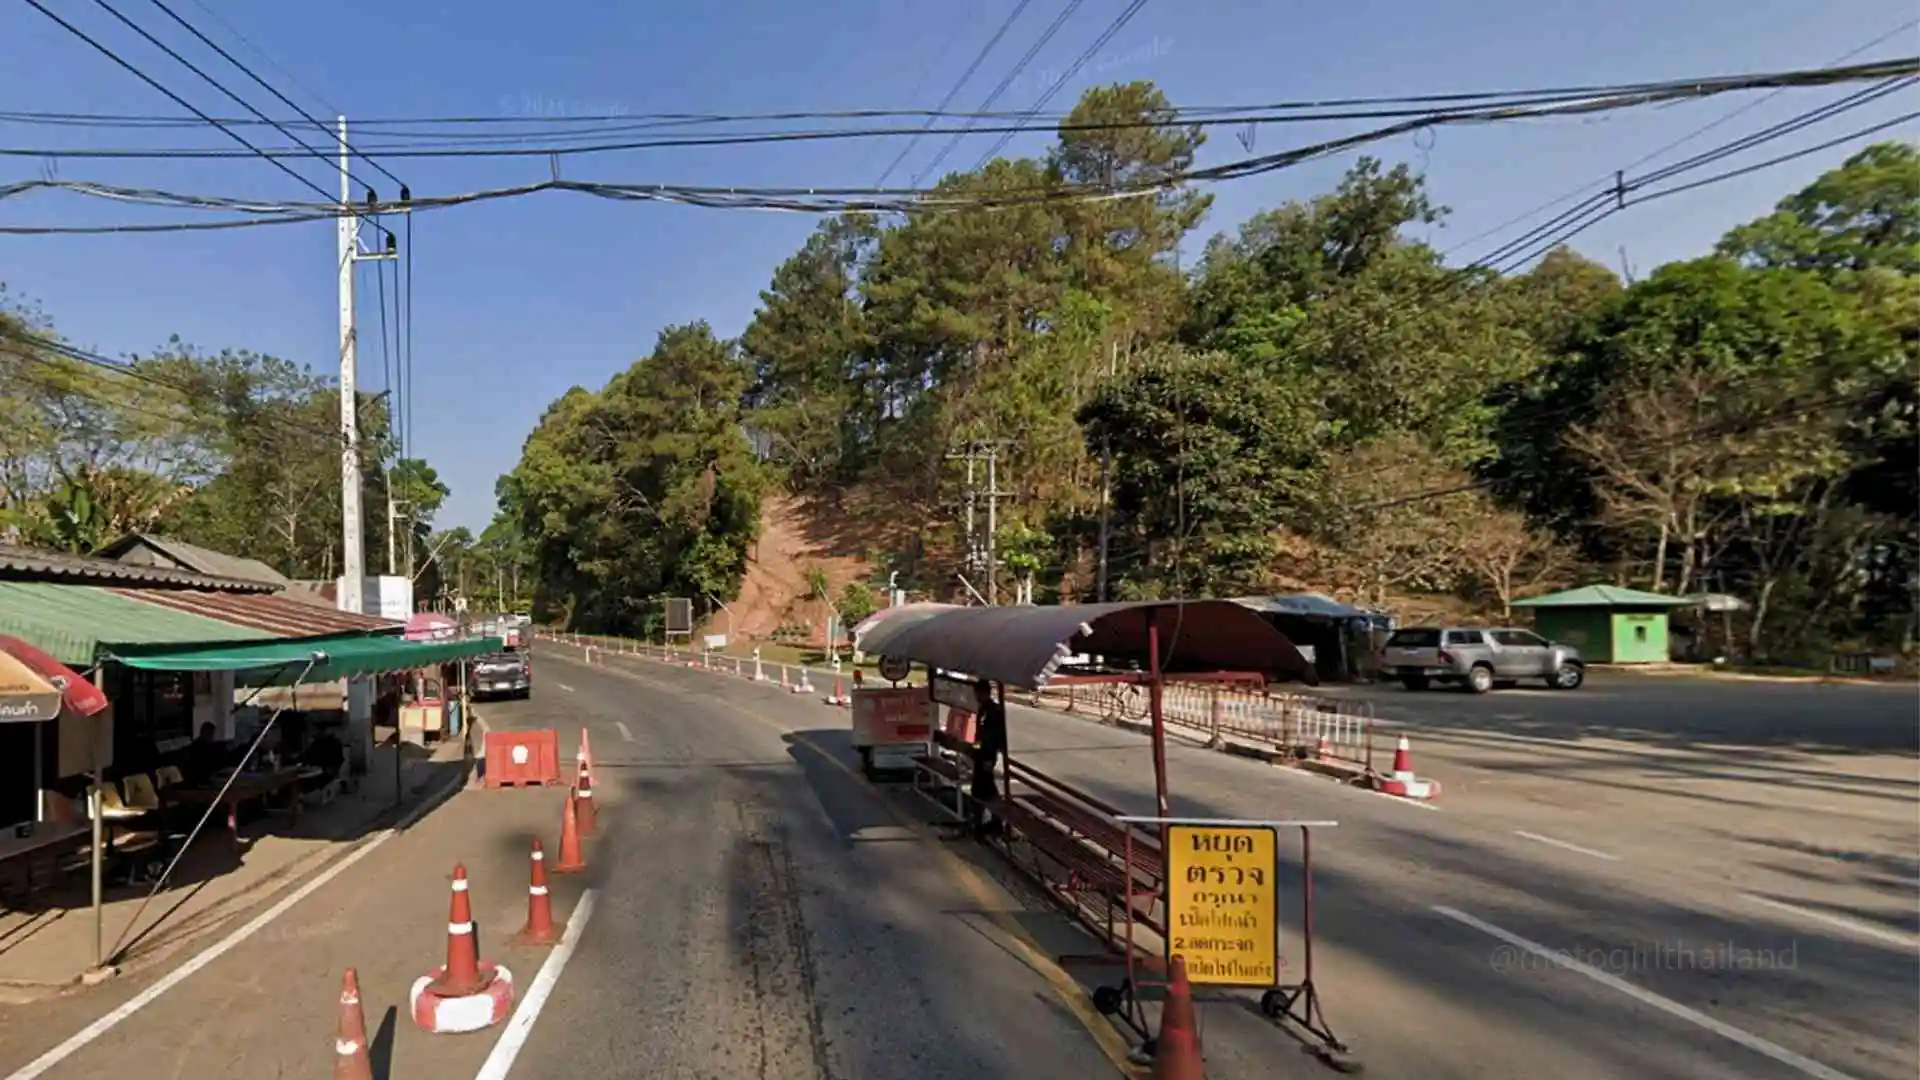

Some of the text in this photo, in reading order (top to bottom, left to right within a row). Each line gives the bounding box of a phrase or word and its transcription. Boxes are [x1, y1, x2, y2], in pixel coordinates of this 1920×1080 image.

[1191, 833, 1255, 862] หยุด
[1186, 863, 1265, 886] ตรวจ
[1193, 891, 1259, 909] กรุณา
